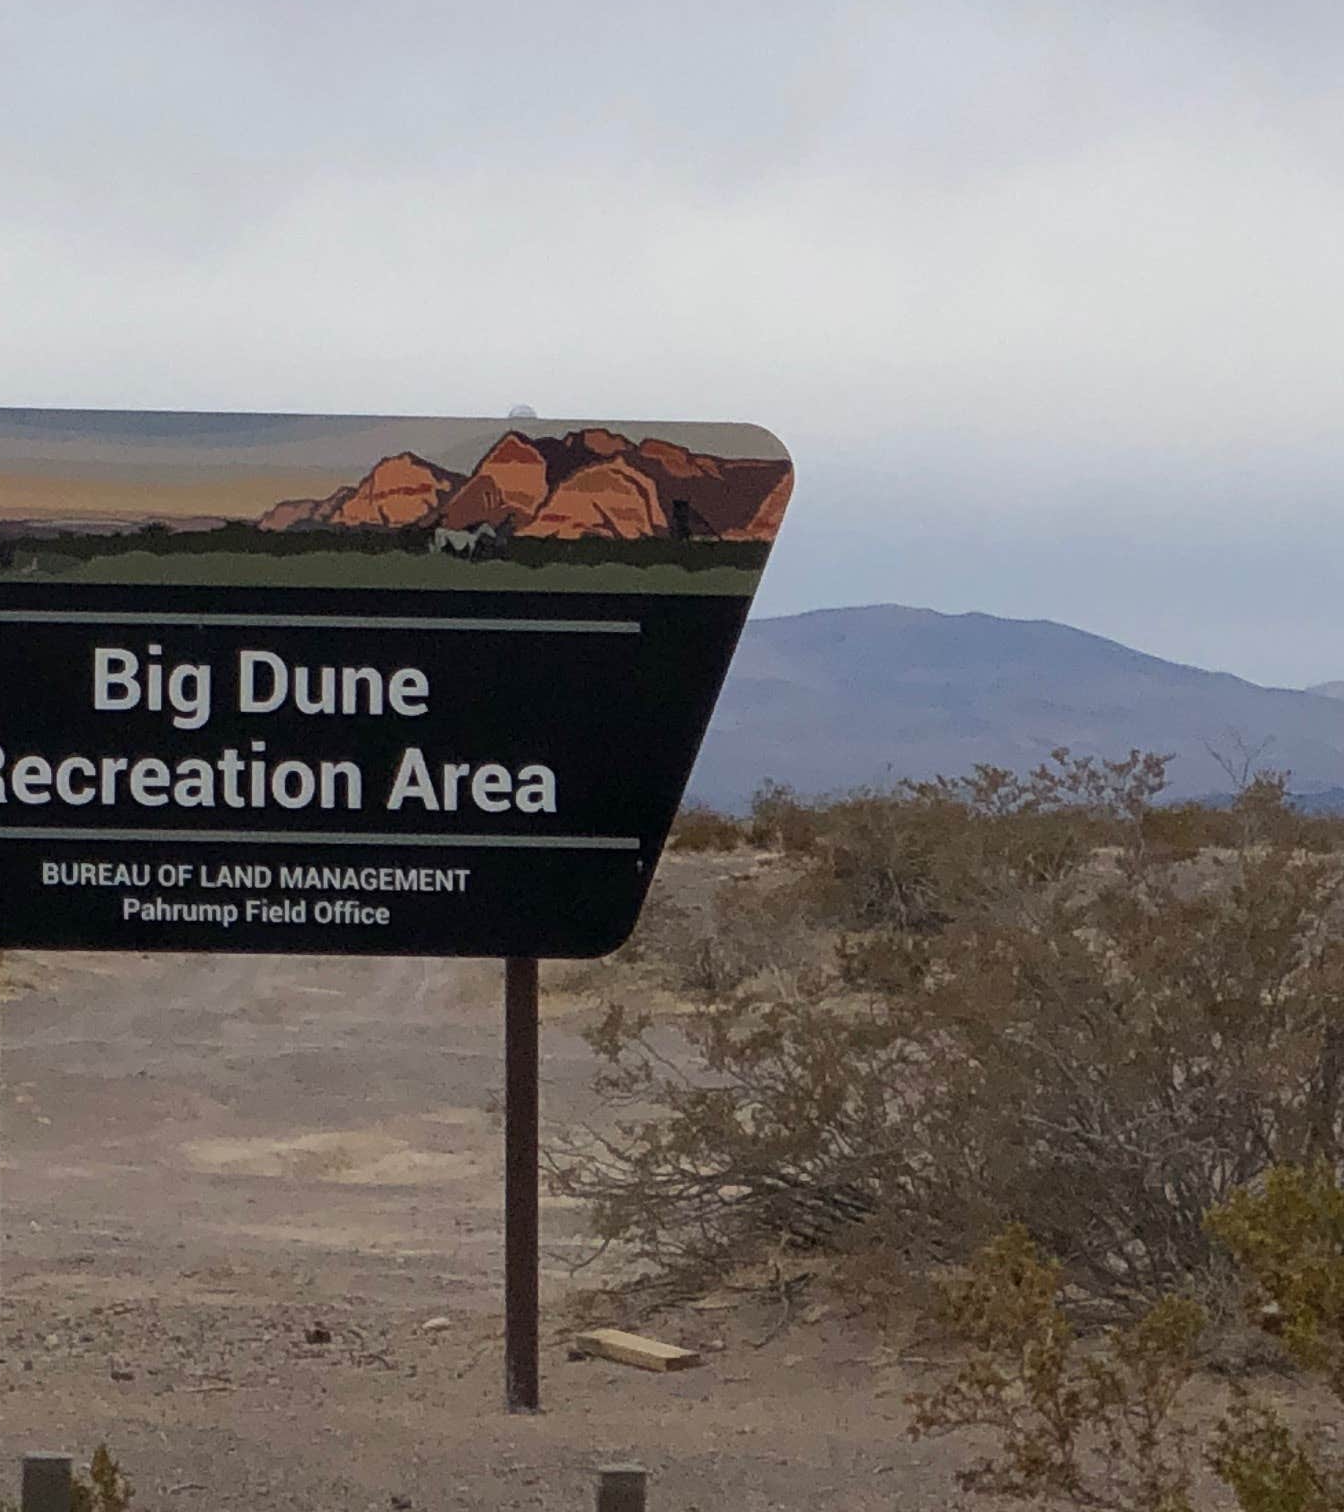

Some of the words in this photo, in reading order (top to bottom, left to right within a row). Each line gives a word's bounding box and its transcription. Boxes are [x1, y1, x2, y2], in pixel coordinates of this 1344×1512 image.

[94, 644, 211, 730] Big
[239, 649, 429, 717] Dune
[386, 747, 557, 813] Area
[42, 862, 151, 886] BUREAU
[158, 864, 193, 887] OF
[200, 865, 272, 889] LAND
[280, 866, 471, 892] MANAGEMENT
[123, 897, 238, 928] Pahrump
[246, 899, 306, 923] Field
[314, 900, 390, 925] Office
